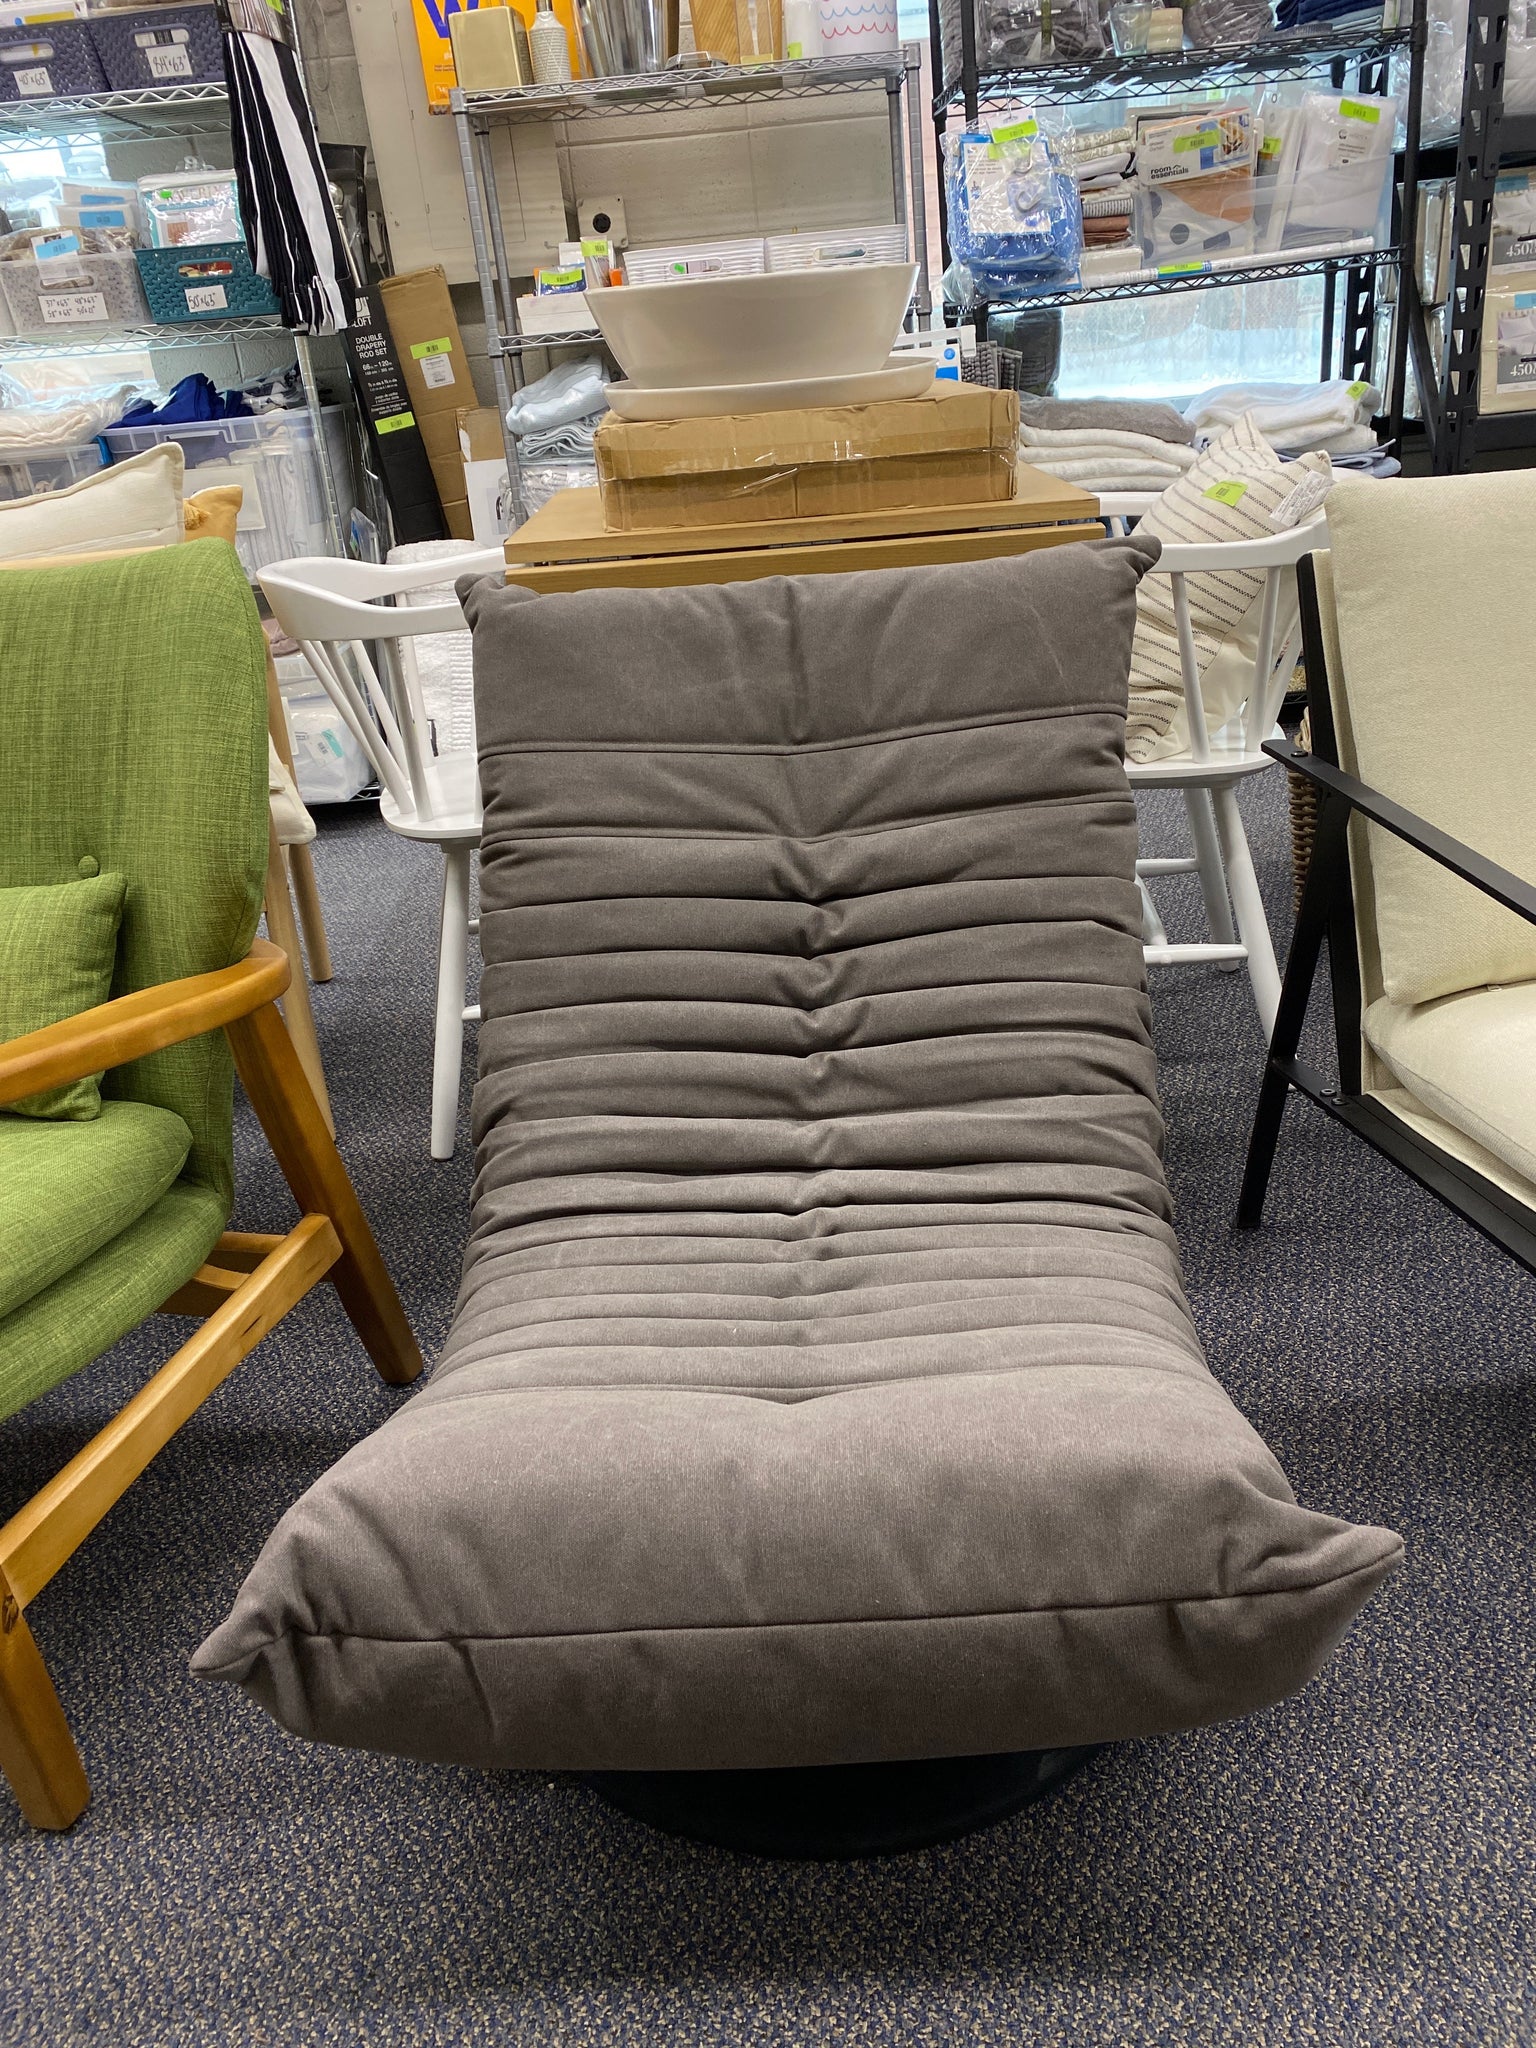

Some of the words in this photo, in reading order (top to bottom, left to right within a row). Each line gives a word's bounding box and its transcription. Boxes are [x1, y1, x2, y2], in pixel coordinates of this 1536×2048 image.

[1150, 165, 1172, 175] room
[1150, 166, 1189, 180] essentials
[354, 315, 372, 328] LOFT
[355, 332, 383, 345] DOUBLE
[355, 340, 387, 352] DRAPERY
[358, 350, 375, 359] ROD
[374, 347, 387, 356] SET
